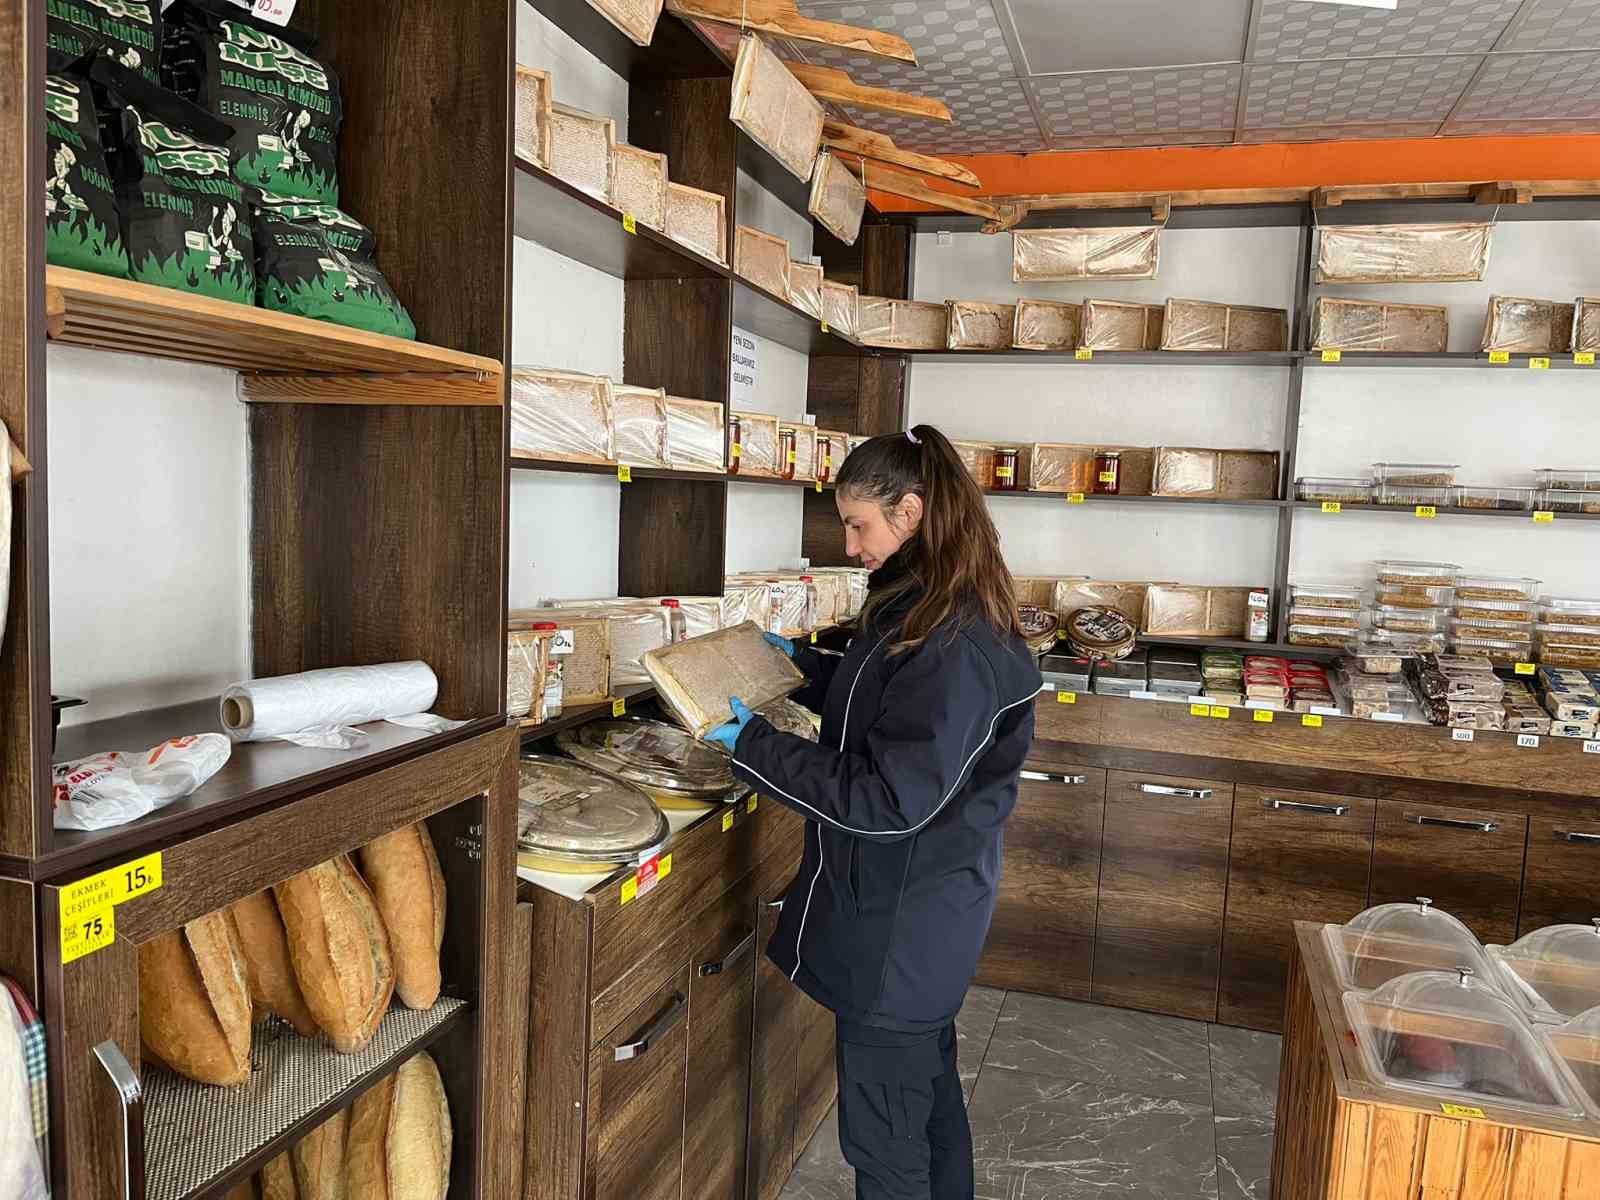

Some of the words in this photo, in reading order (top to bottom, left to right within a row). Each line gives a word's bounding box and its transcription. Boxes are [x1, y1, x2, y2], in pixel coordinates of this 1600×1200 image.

[220, 70, 285, 96] MANGAL
[71, 878, 107, 900] EKMEK
[83, 918, 103, 940] 75
